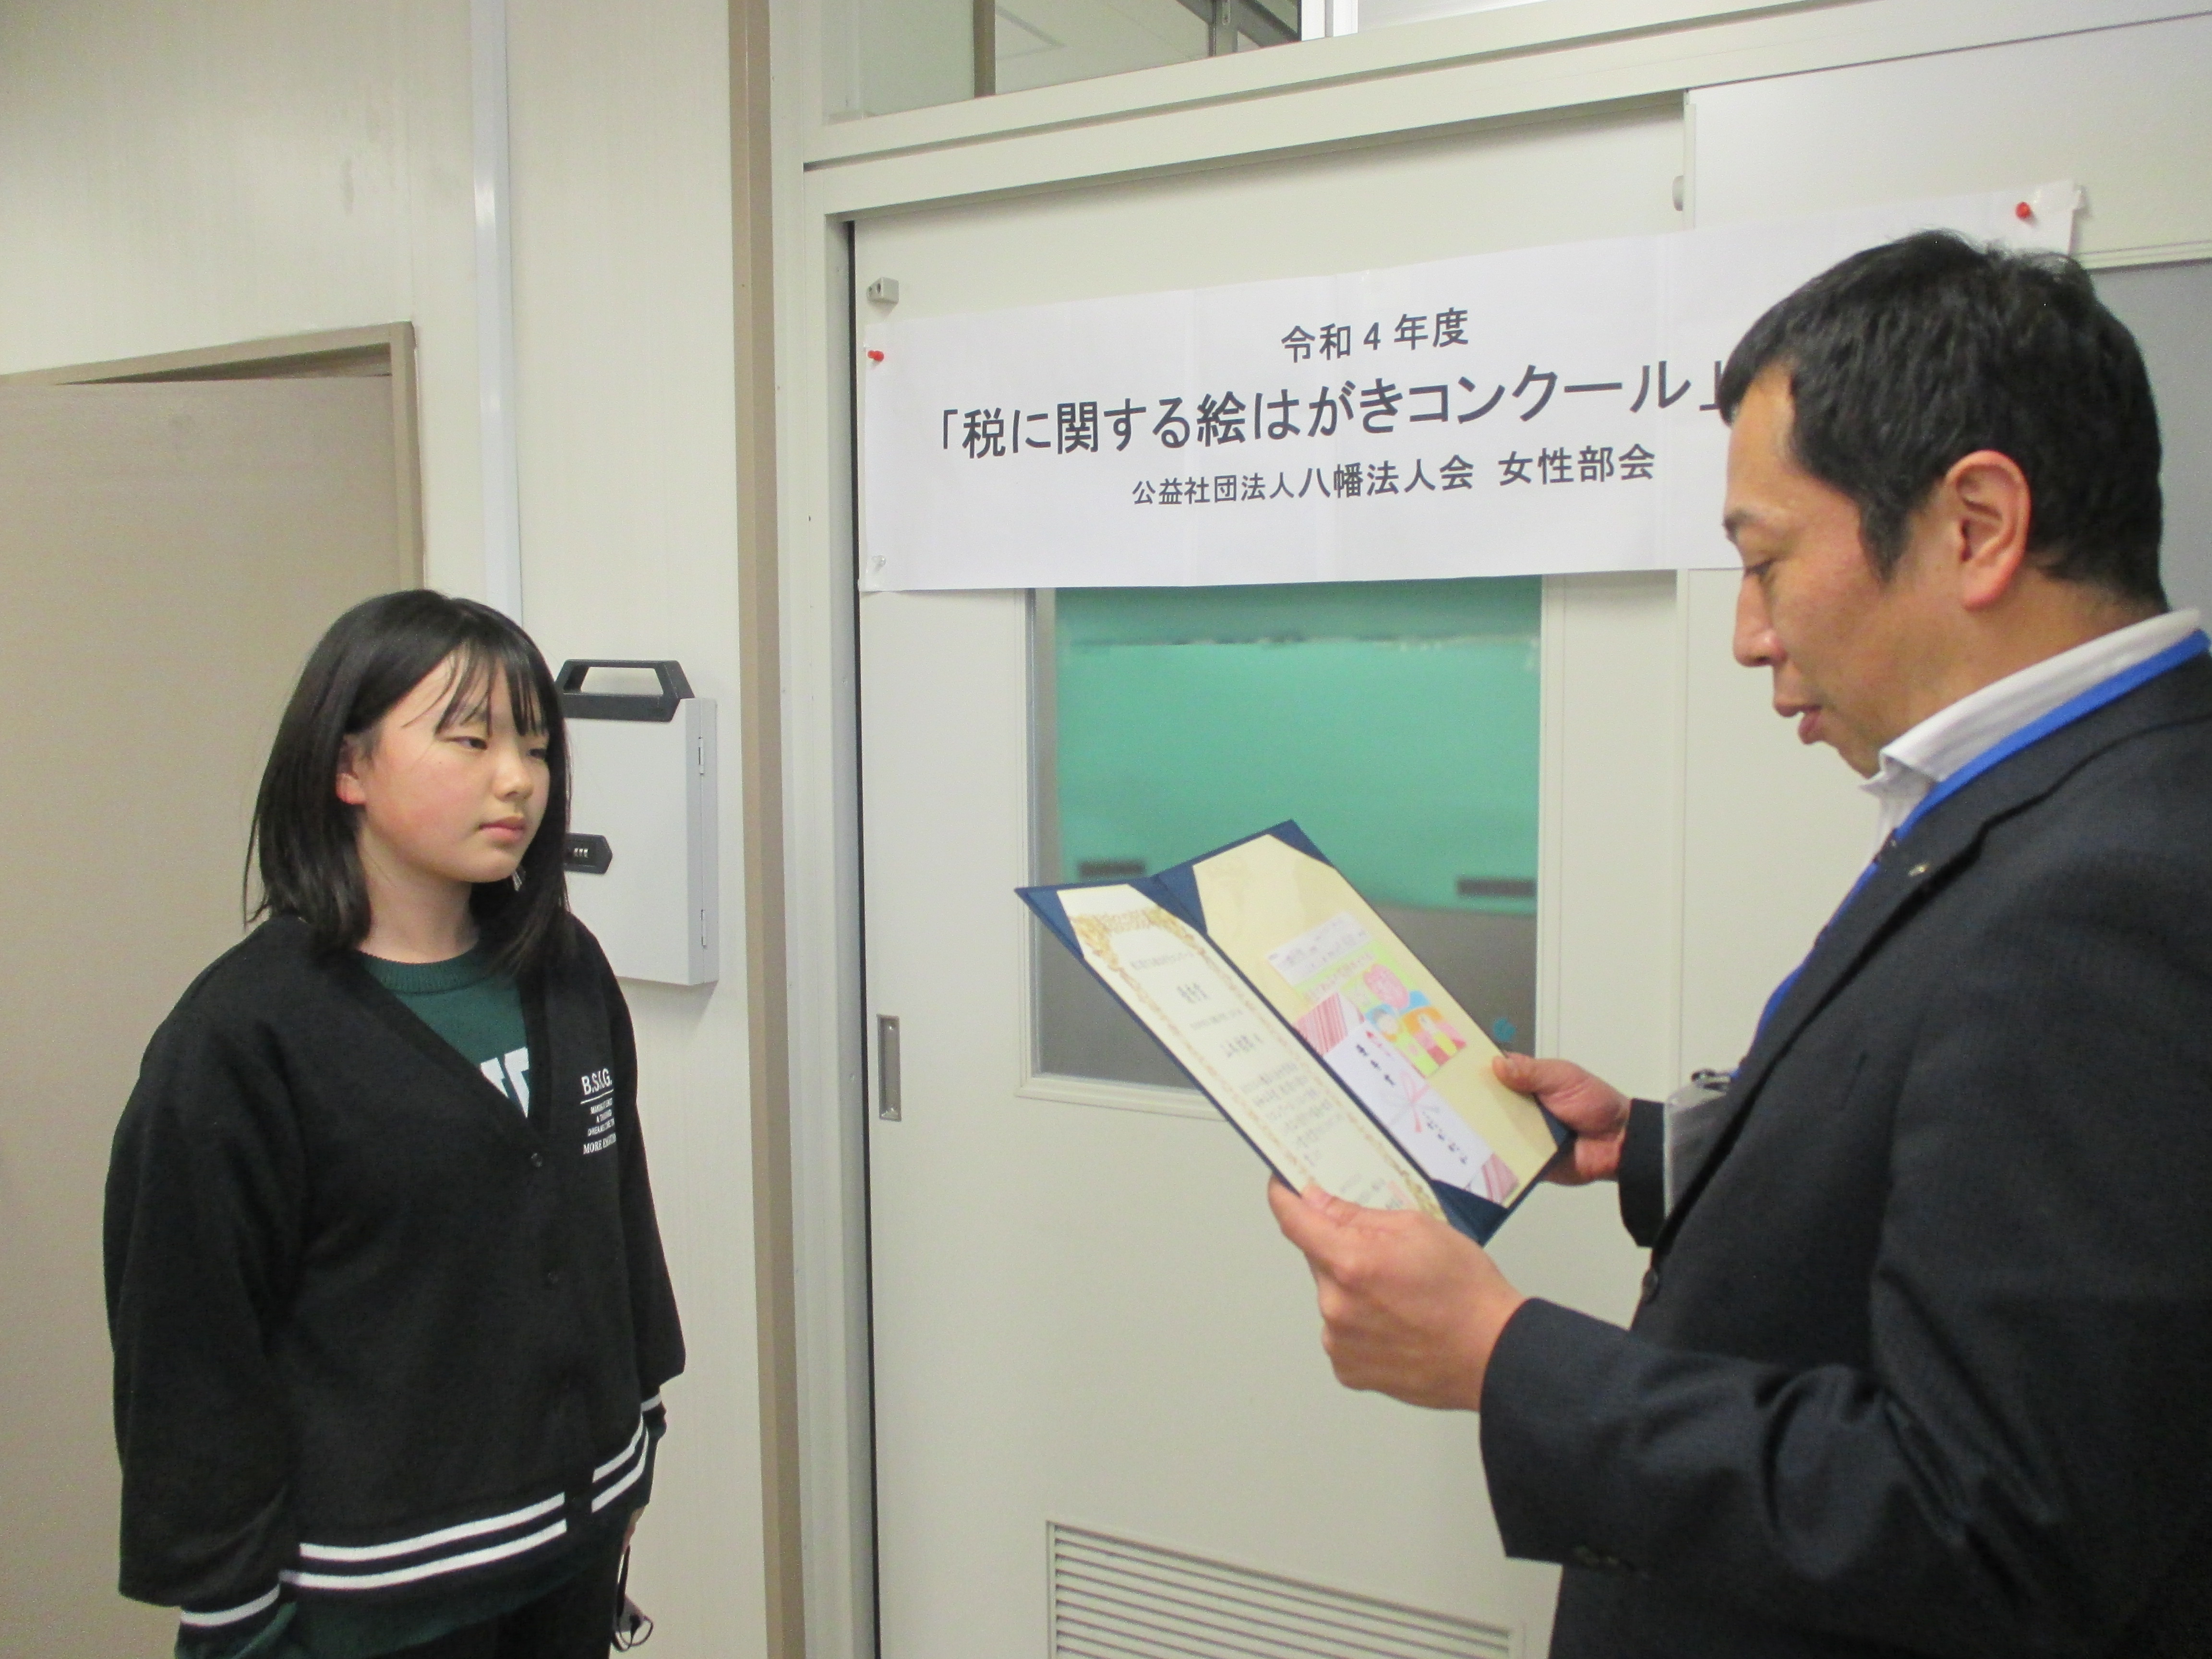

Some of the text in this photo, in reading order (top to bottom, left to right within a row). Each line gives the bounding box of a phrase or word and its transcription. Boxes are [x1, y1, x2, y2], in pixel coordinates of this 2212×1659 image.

[1281, 307, 1469, 363] 令和4年度
[939, 359, 1722, 459] 「税に関する絵はがきコンクール」
[1132, 443, 1656, 505] 公益社団法人八幡法人会 女性部会
[582, 1140, 602, 1155] MORE
